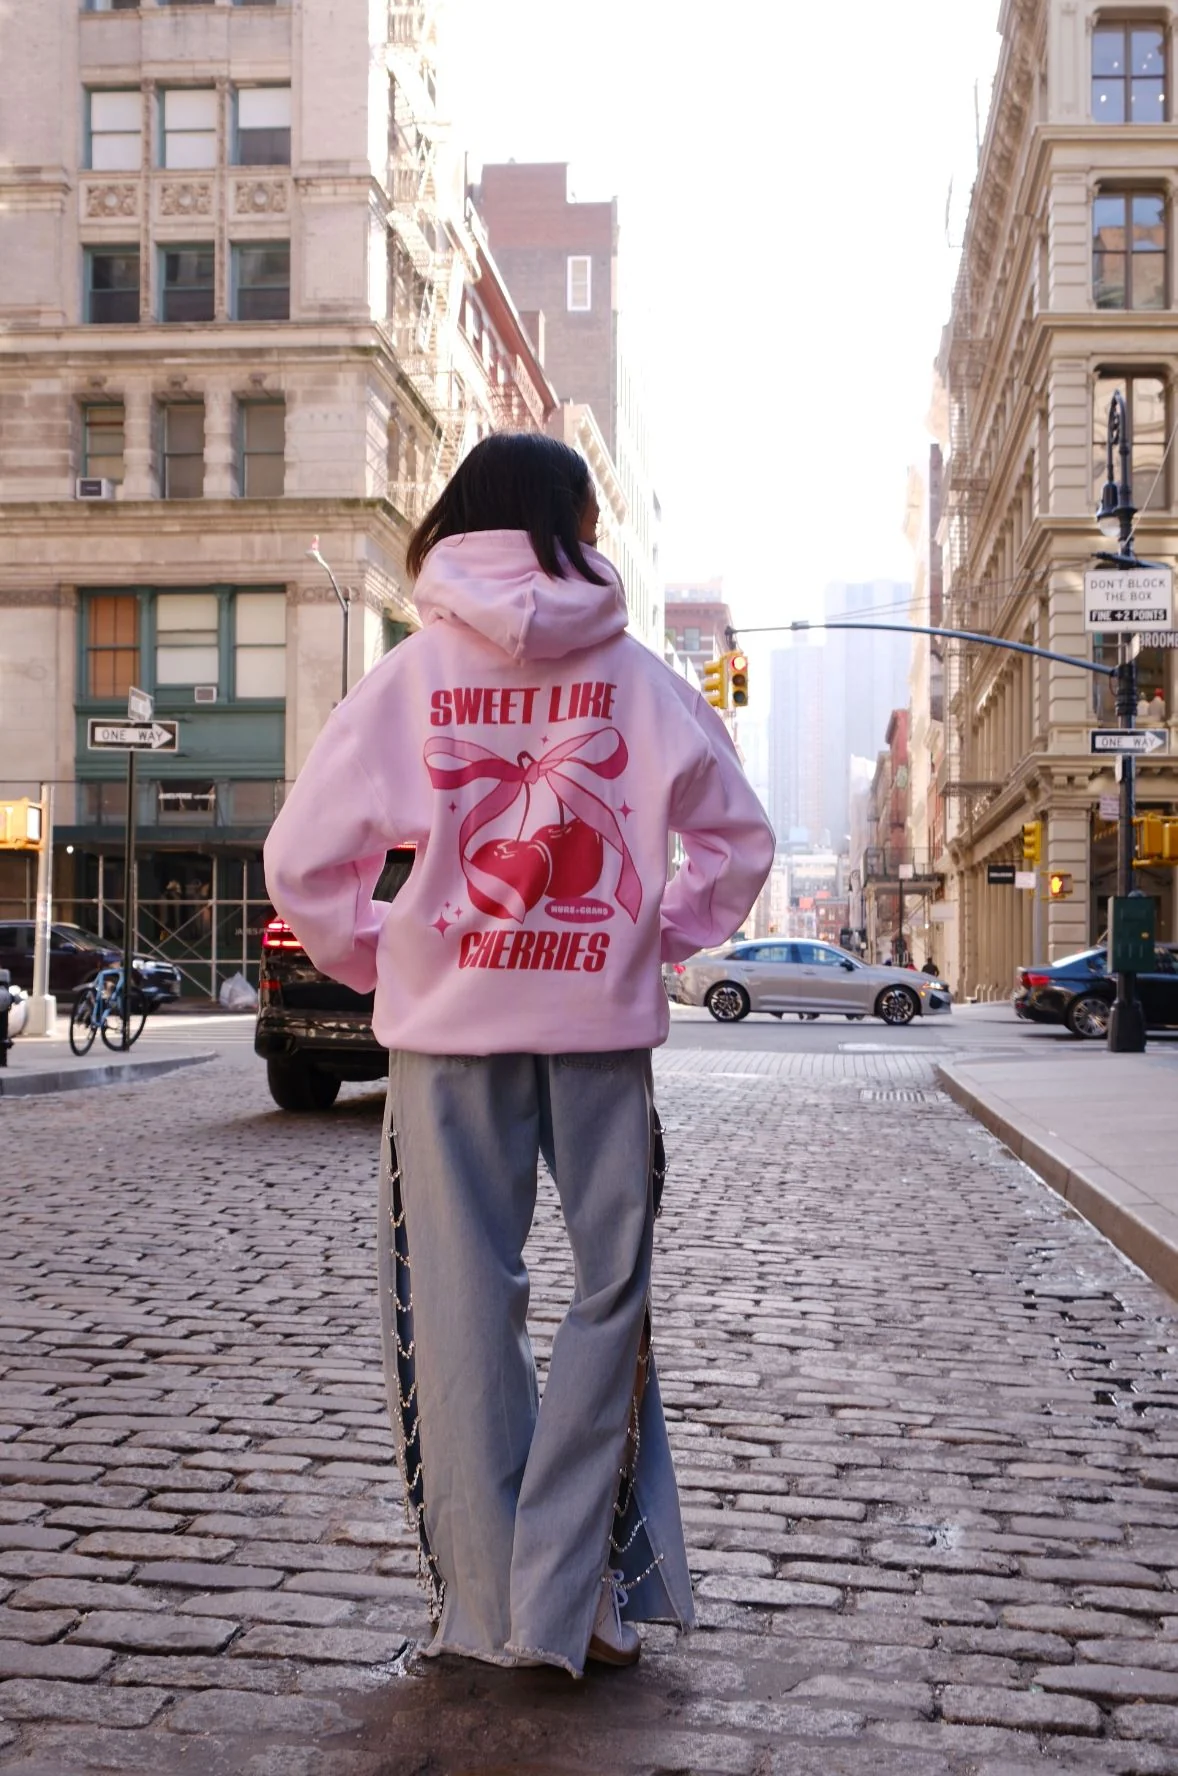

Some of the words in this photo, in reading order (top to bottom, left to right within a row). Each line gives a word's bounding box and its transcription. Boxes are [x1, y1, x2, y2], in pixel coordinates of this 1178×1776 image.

[1128, 577, 1166, 588] BLOCK
[1105, 592, 1126, 601] THE
[1130, 591, 1152, 601] BOX
[1092, 610, 1112, 621] FINE
[1132, 609, 1165, 621] POINTS
[430, 687, 540, 726] SWEET
[548, 682, 617, 723] LIKE
[102, 729, 126, 740] ONE
[138, 731, 163, 741] WAY
[1101, 737, 1122, 747] ONE
[1133, 737, 1155, 746] WAY
[458, 929, 610, 973] CHERRIES
